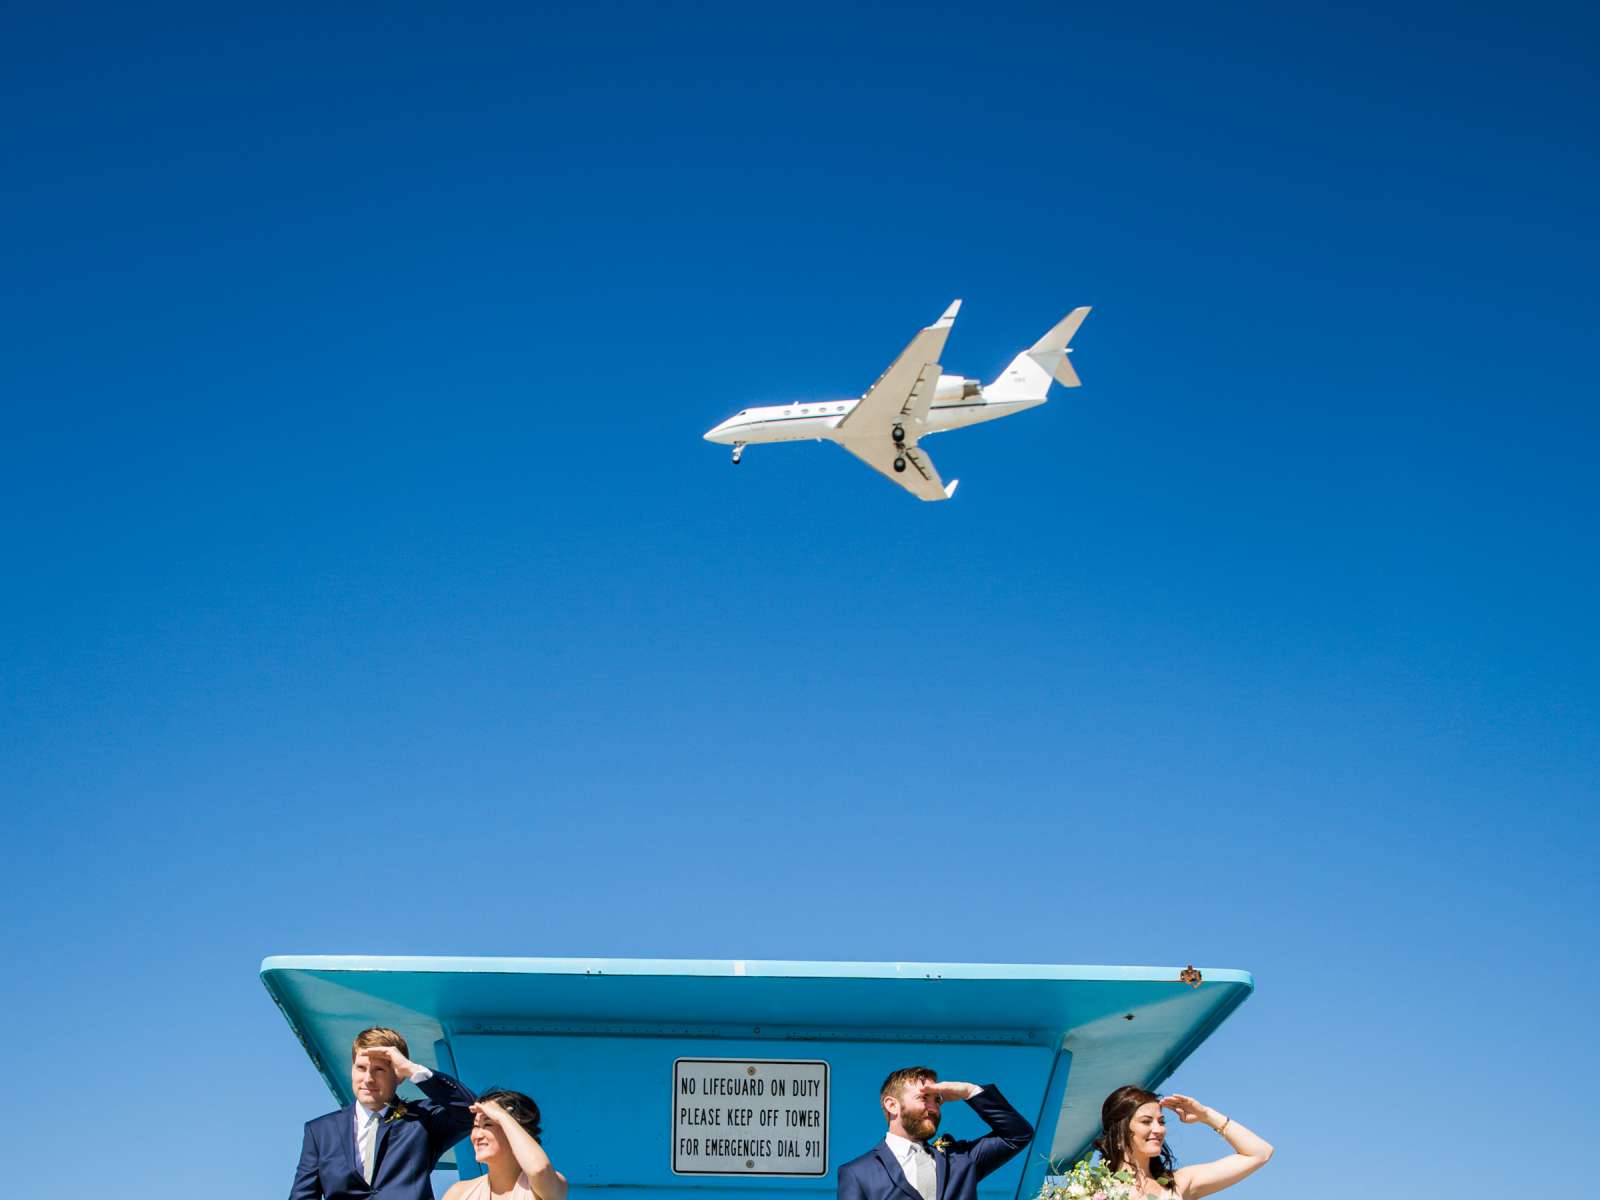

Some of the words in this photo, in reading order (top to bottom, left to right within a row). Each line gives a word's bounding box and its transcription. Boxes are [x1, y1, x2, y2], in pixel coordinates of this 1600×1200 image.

[681, 1078, 695, 1095] NO
[703, 1078, 764, 1096] LIFEGUARD
[771, 1080, 785, 1096] ON
[793, 1080, 820, 1096] DUTY
[681, 1108, 720, 1125] PLEASE
[728, 1109, 753, 1126] KEEP
[760, 1110, 779, 1126] OFF
[786, 1110, 820, 1127] TOWER
[680, 1139, 699, 1156] FOR
[706, 1139, 771, 1156] EMERGENCIES
[778, 1140, 800, 1157] DIAL
[805, 1141, 820, 1157] 911
